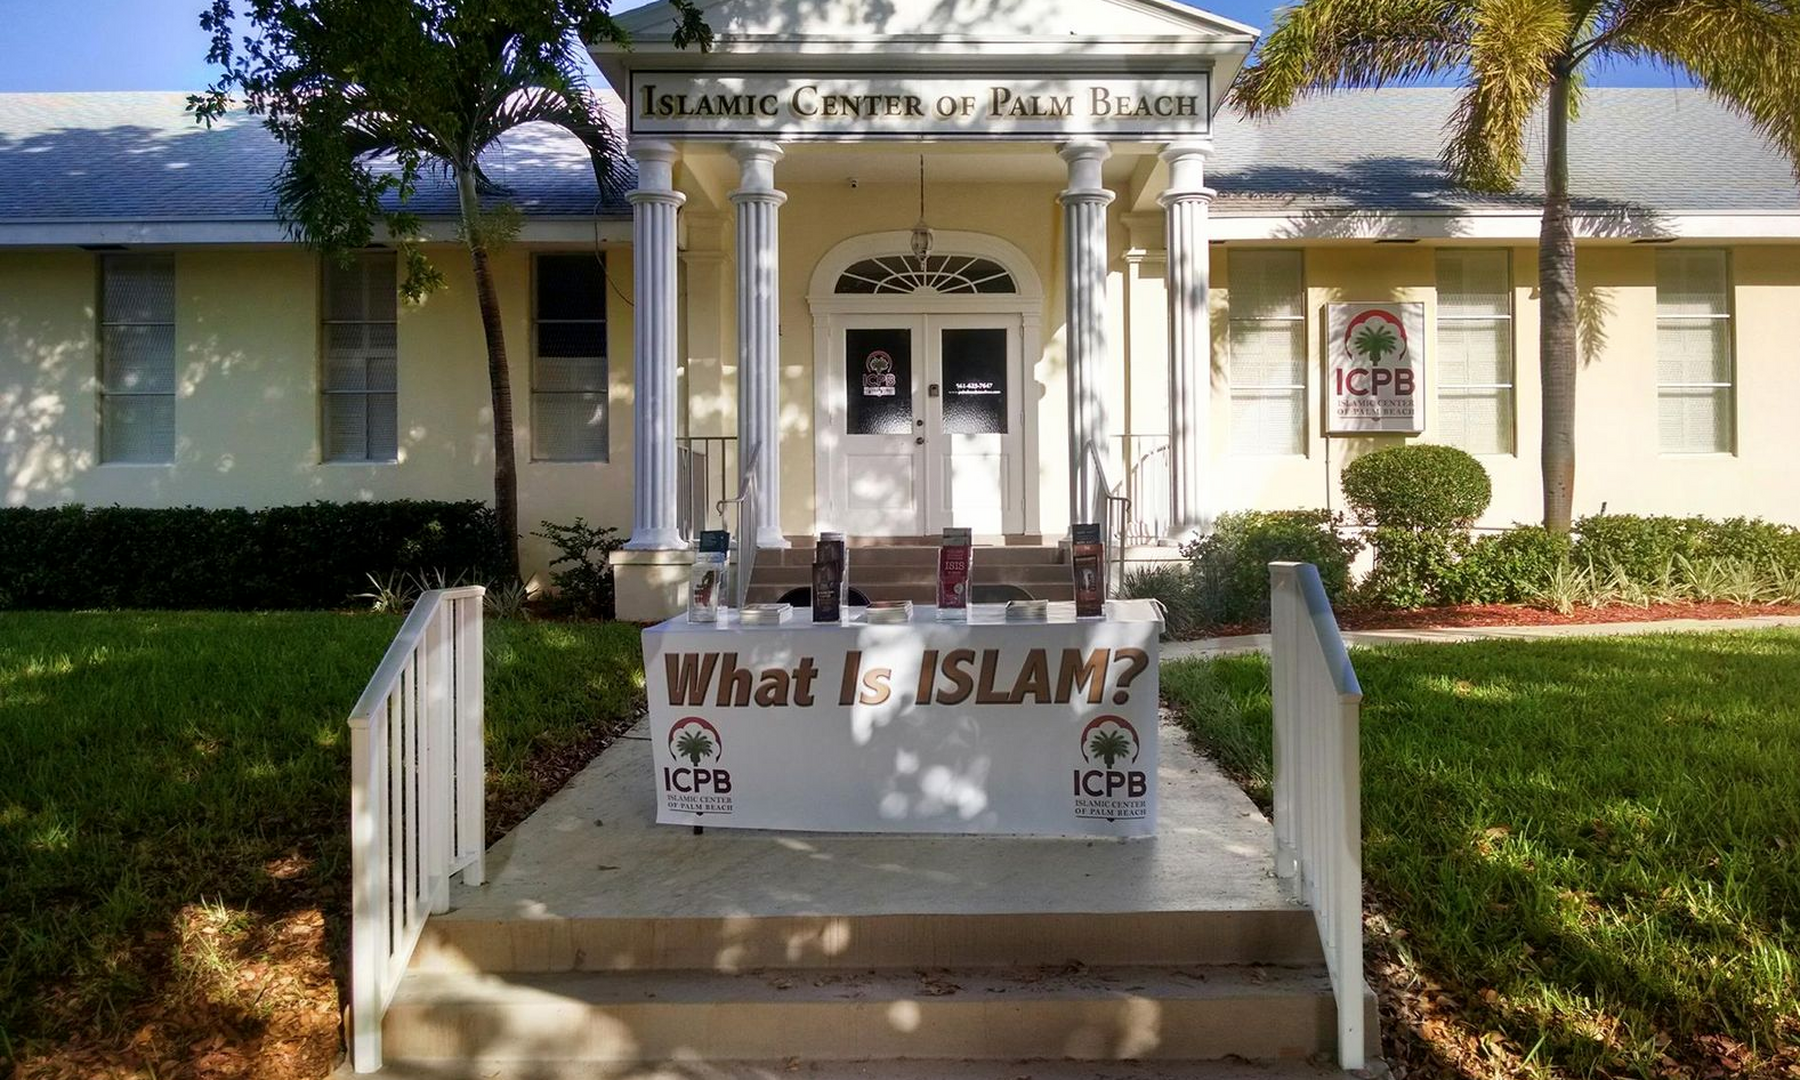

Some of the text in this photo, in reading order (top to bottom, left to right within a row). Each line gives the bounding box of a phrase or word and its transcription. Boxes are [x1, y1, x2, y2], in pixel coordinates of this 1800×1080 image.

[641, 84, 779, 117] ISLAMIC
[790, 84, 926, 118] CENTER
[988, 86, 1075, 118] PALM
[1088, 86, 1200, 117] BEACH
[862, 373, 896, 387] ICPB
[1336, 367, 1415, 396] ICPB
[1337, 399, 1415, 408] ISLAMIC CENTER
[1337, 408, 1415, 416] OF PALM BEACH
[944, 561, 966, 571] ISIS
[664, 648, 1150, 707] What Is ISLAM?
[663, 766, 732, 794] ICPB
[1073, 769, 1147, 798] ICPB
[666, 794, 733, 804] ISLAMIC CENTER
[1075, 799, 1111, 808] ISLAMIC
